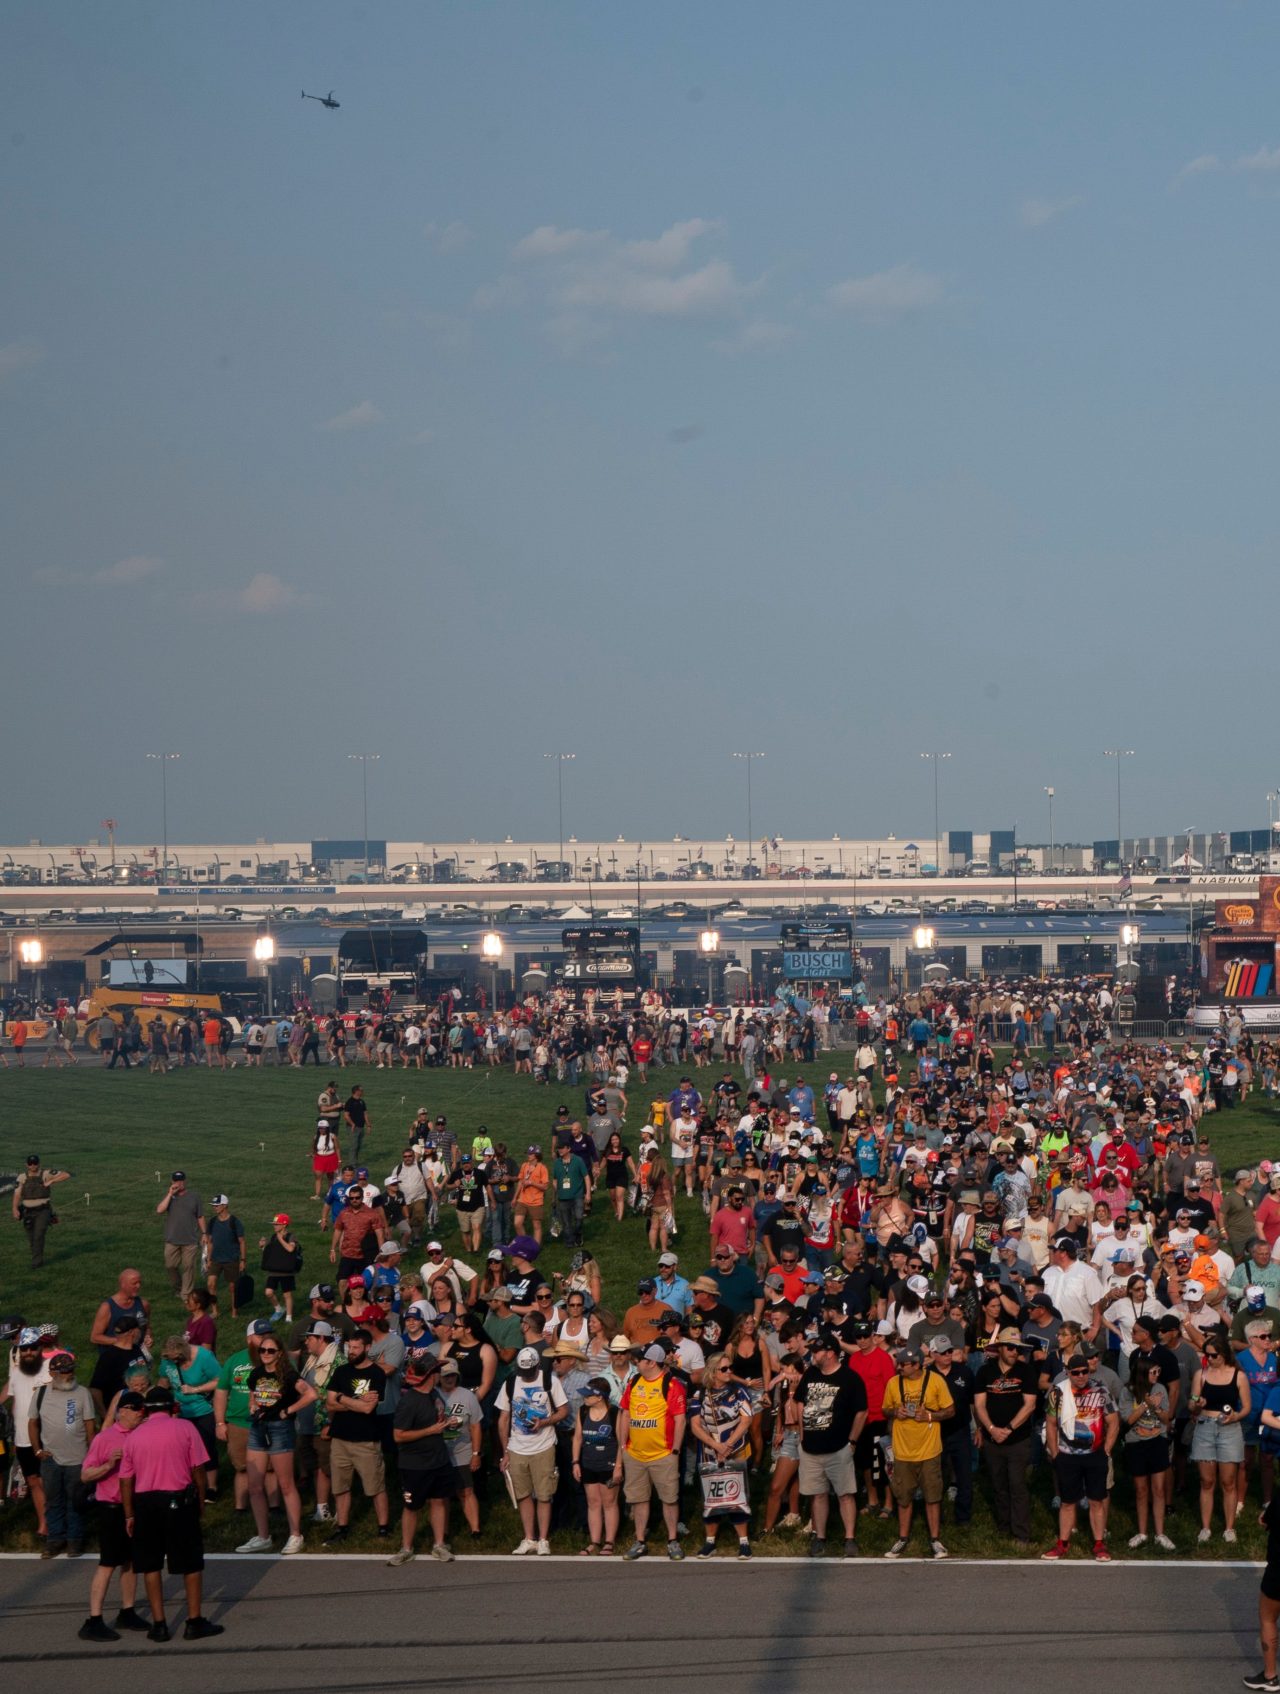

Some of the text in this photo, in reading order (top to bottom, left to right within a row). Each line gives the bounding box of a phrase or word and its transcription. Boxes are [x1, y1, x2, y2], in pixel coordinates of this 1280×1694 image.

[426, 924, 773, 936] RACLEY
[856, 920, 1148, 930] OOFING
[791, 954, 841, 968] BUSCH
[565, 964, 580, 976] 21
[518, 1279, 531, 1288] 11
[532, 1391, 547, 1405] 9
[450, 1403, 464, 1414] 16
[630, 1418, 657, 1428] ENNZOIL
